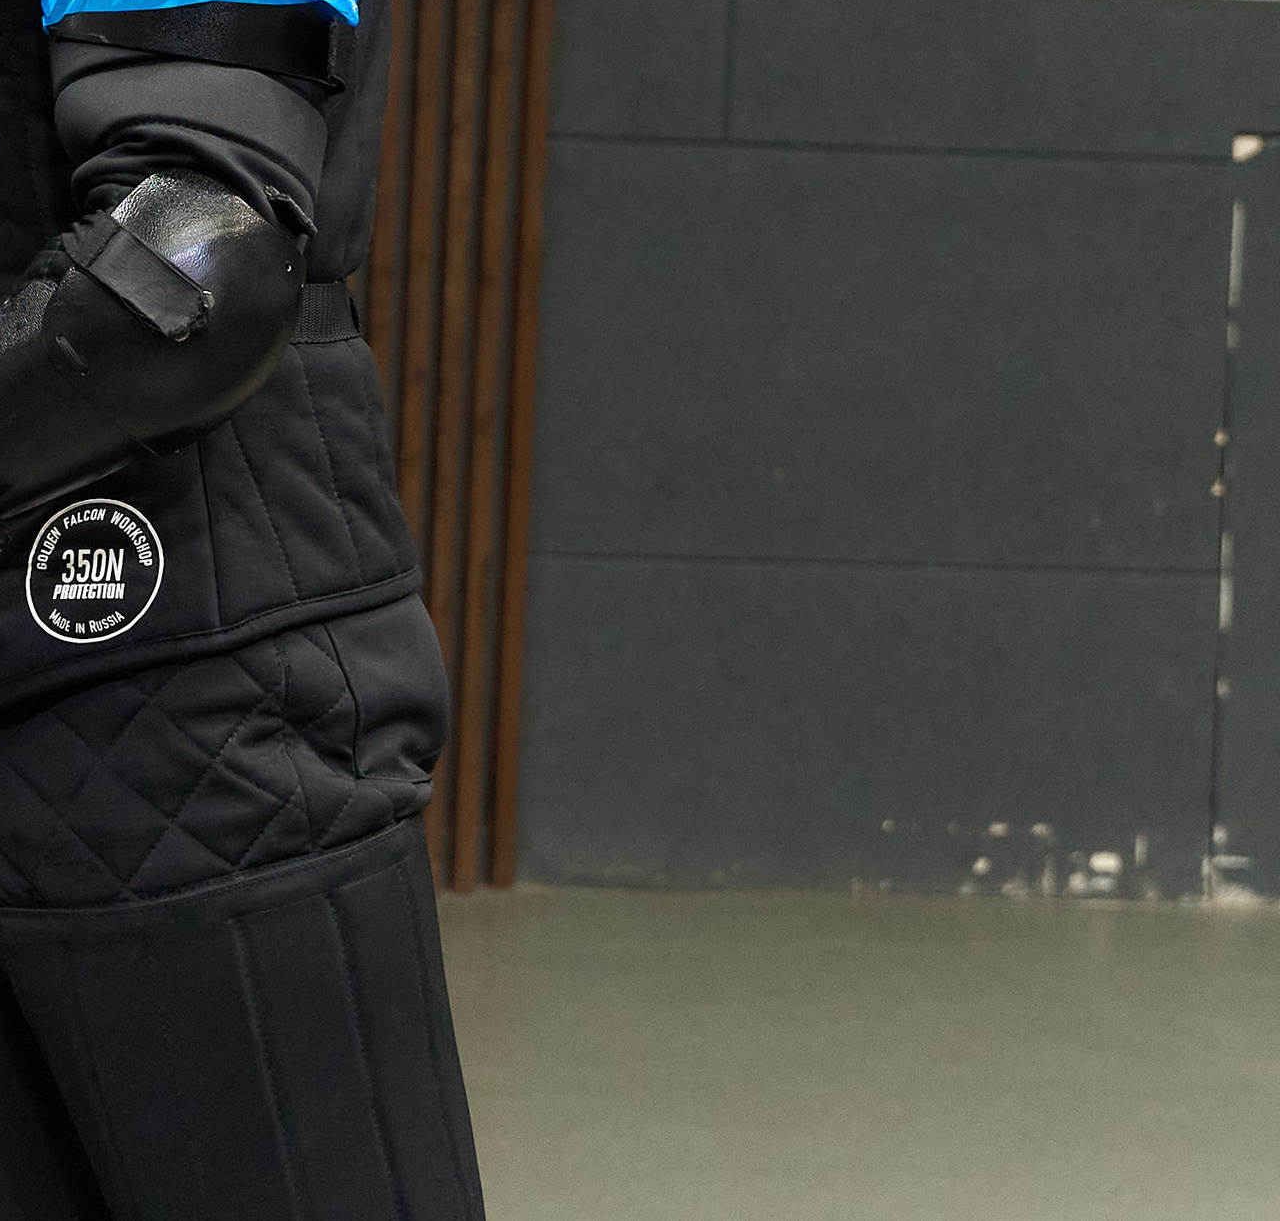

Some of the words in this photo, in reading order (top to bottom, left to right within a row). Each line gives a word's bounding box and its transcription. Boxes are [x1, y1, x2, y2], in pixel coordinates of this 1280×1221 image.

[37, 526, 62, 570] GOLDEN
[63, 508, 107, 529] FALCON
[110, 510, 153, 567] WORKSHOP
[61, 548, 125, 583] 350N
[52, 582, 125, 600] PROTECTION
